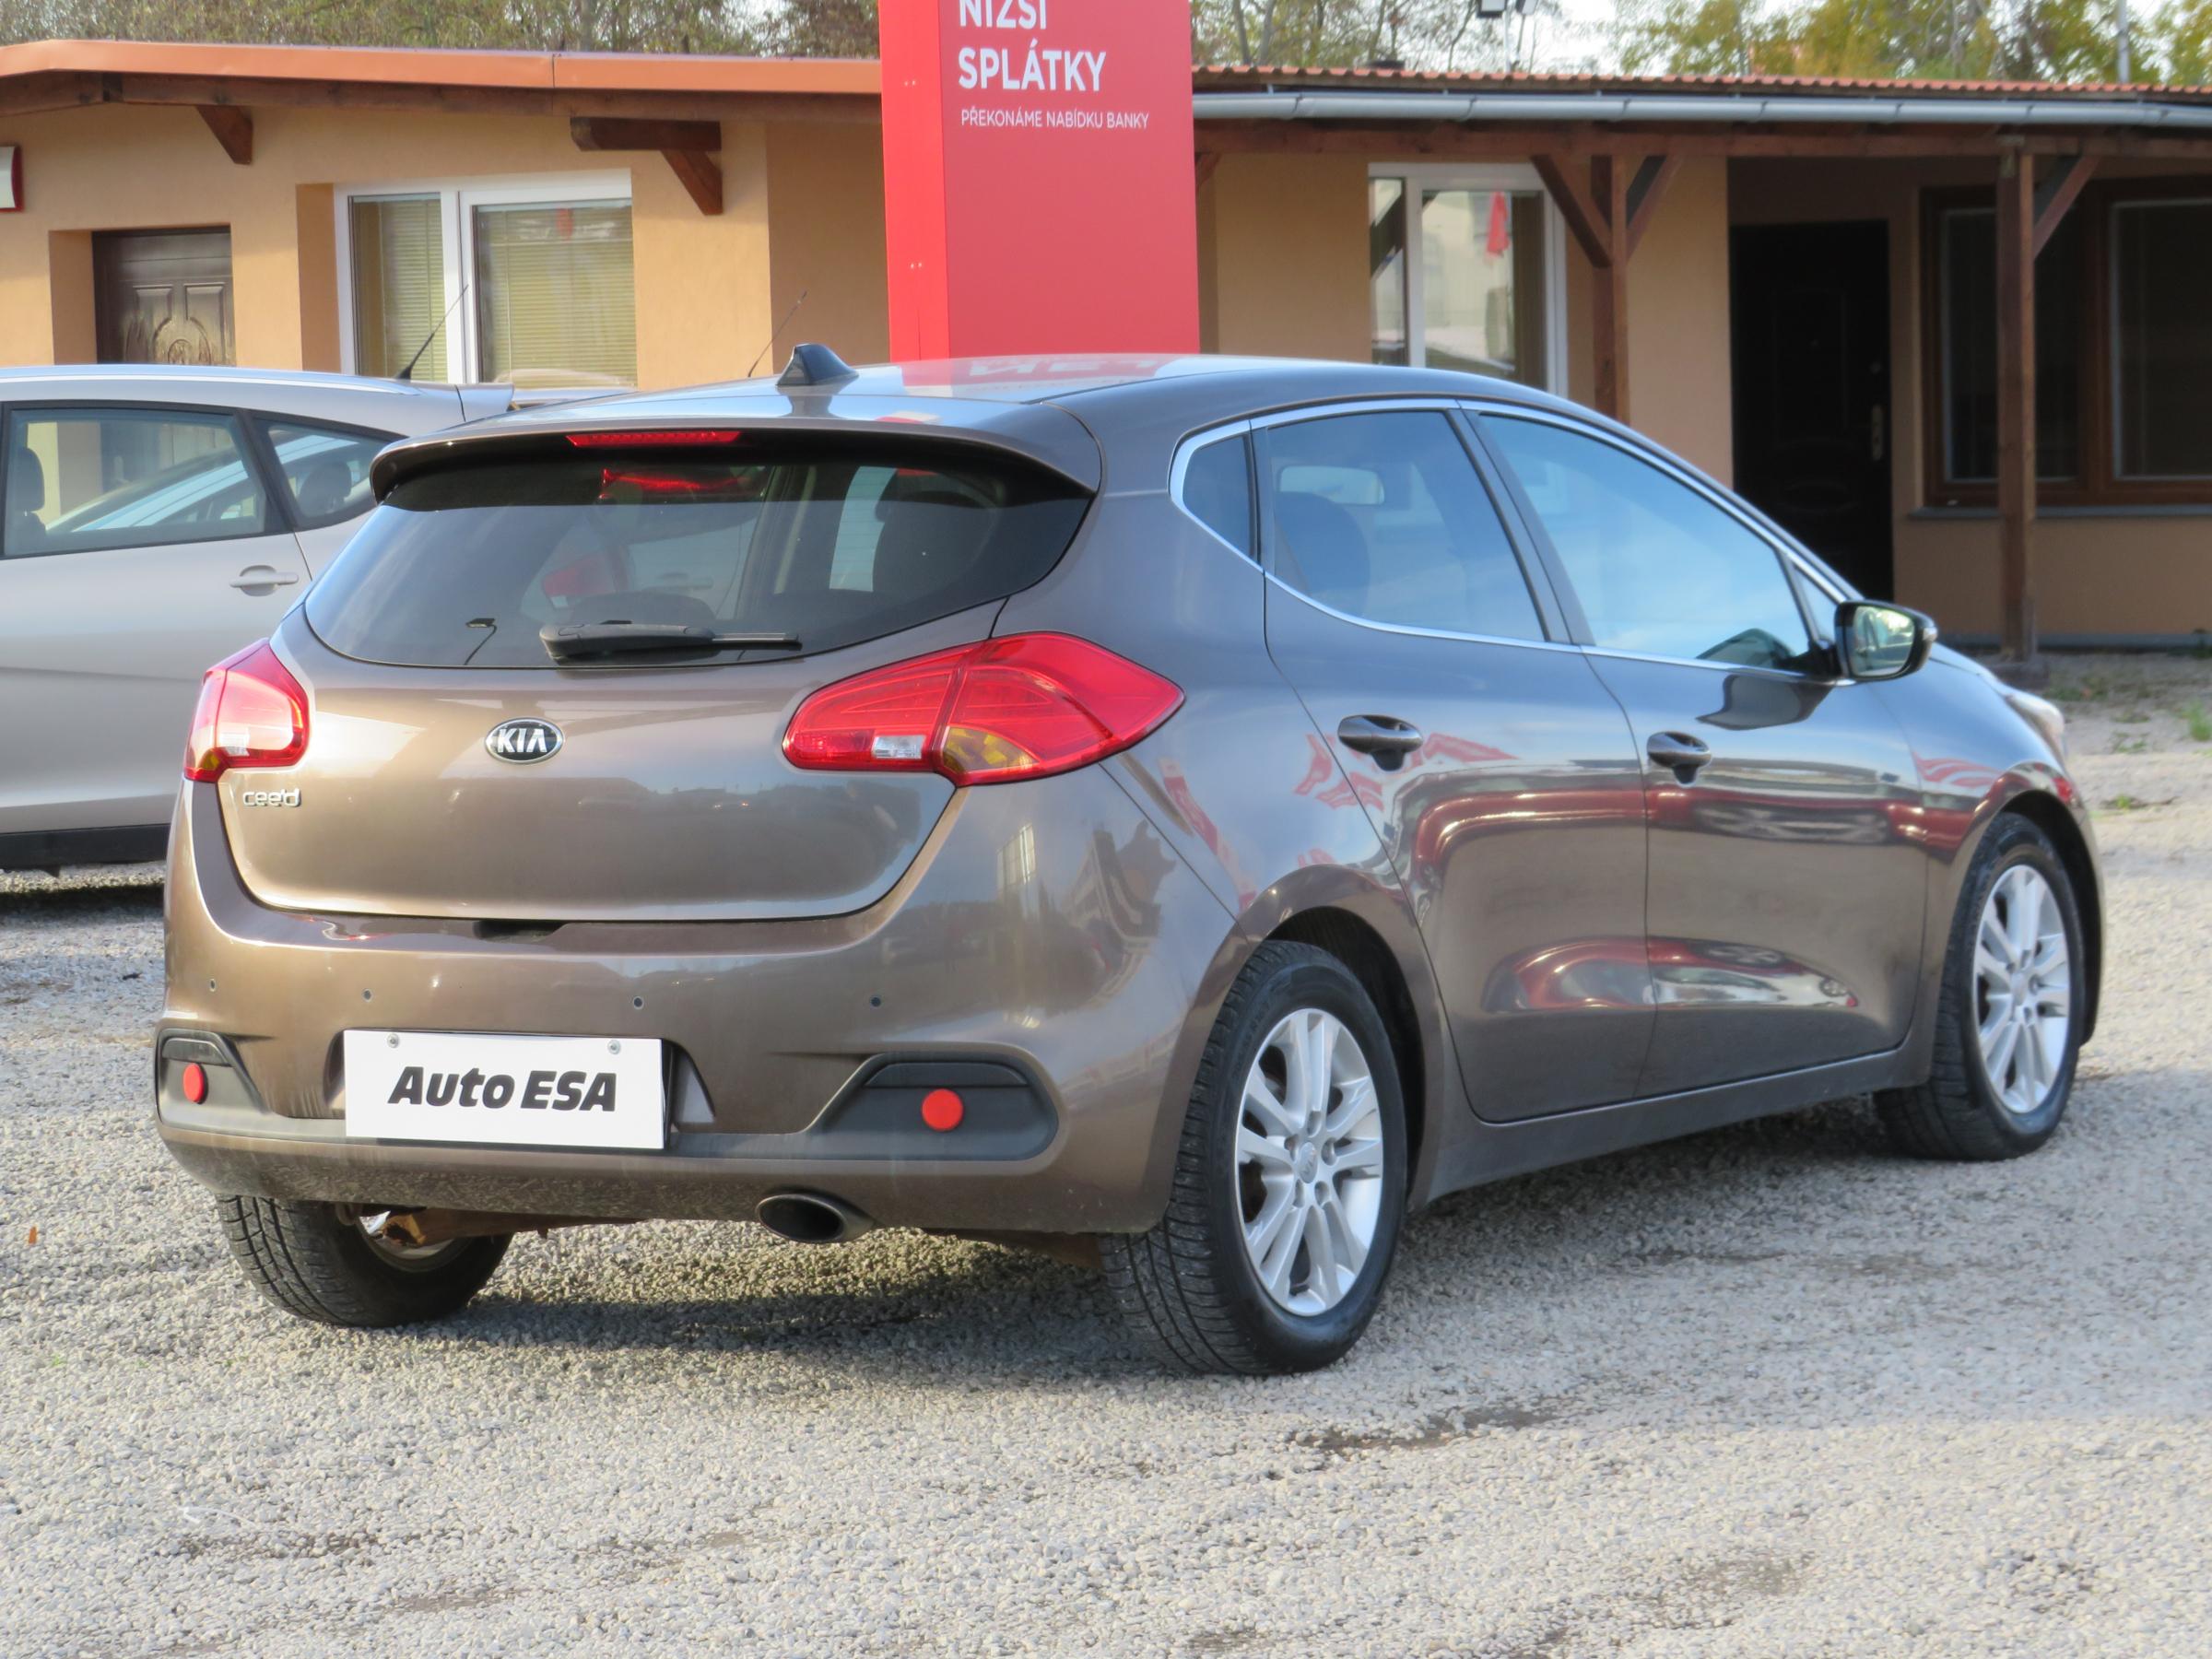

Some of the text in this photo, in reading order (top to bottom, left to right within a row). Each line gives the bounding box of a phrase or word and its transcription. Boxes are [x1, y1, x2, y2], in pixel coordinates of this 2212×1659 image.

[958, 38, 1106, 91] SPLÁTKY
[961, 106, 1149, 129] PŘEKONÁME NABÍDKU BANKY
[497, 728, 548, 753] KIA
[387, 1066, 617, 1112] Auto ESA
